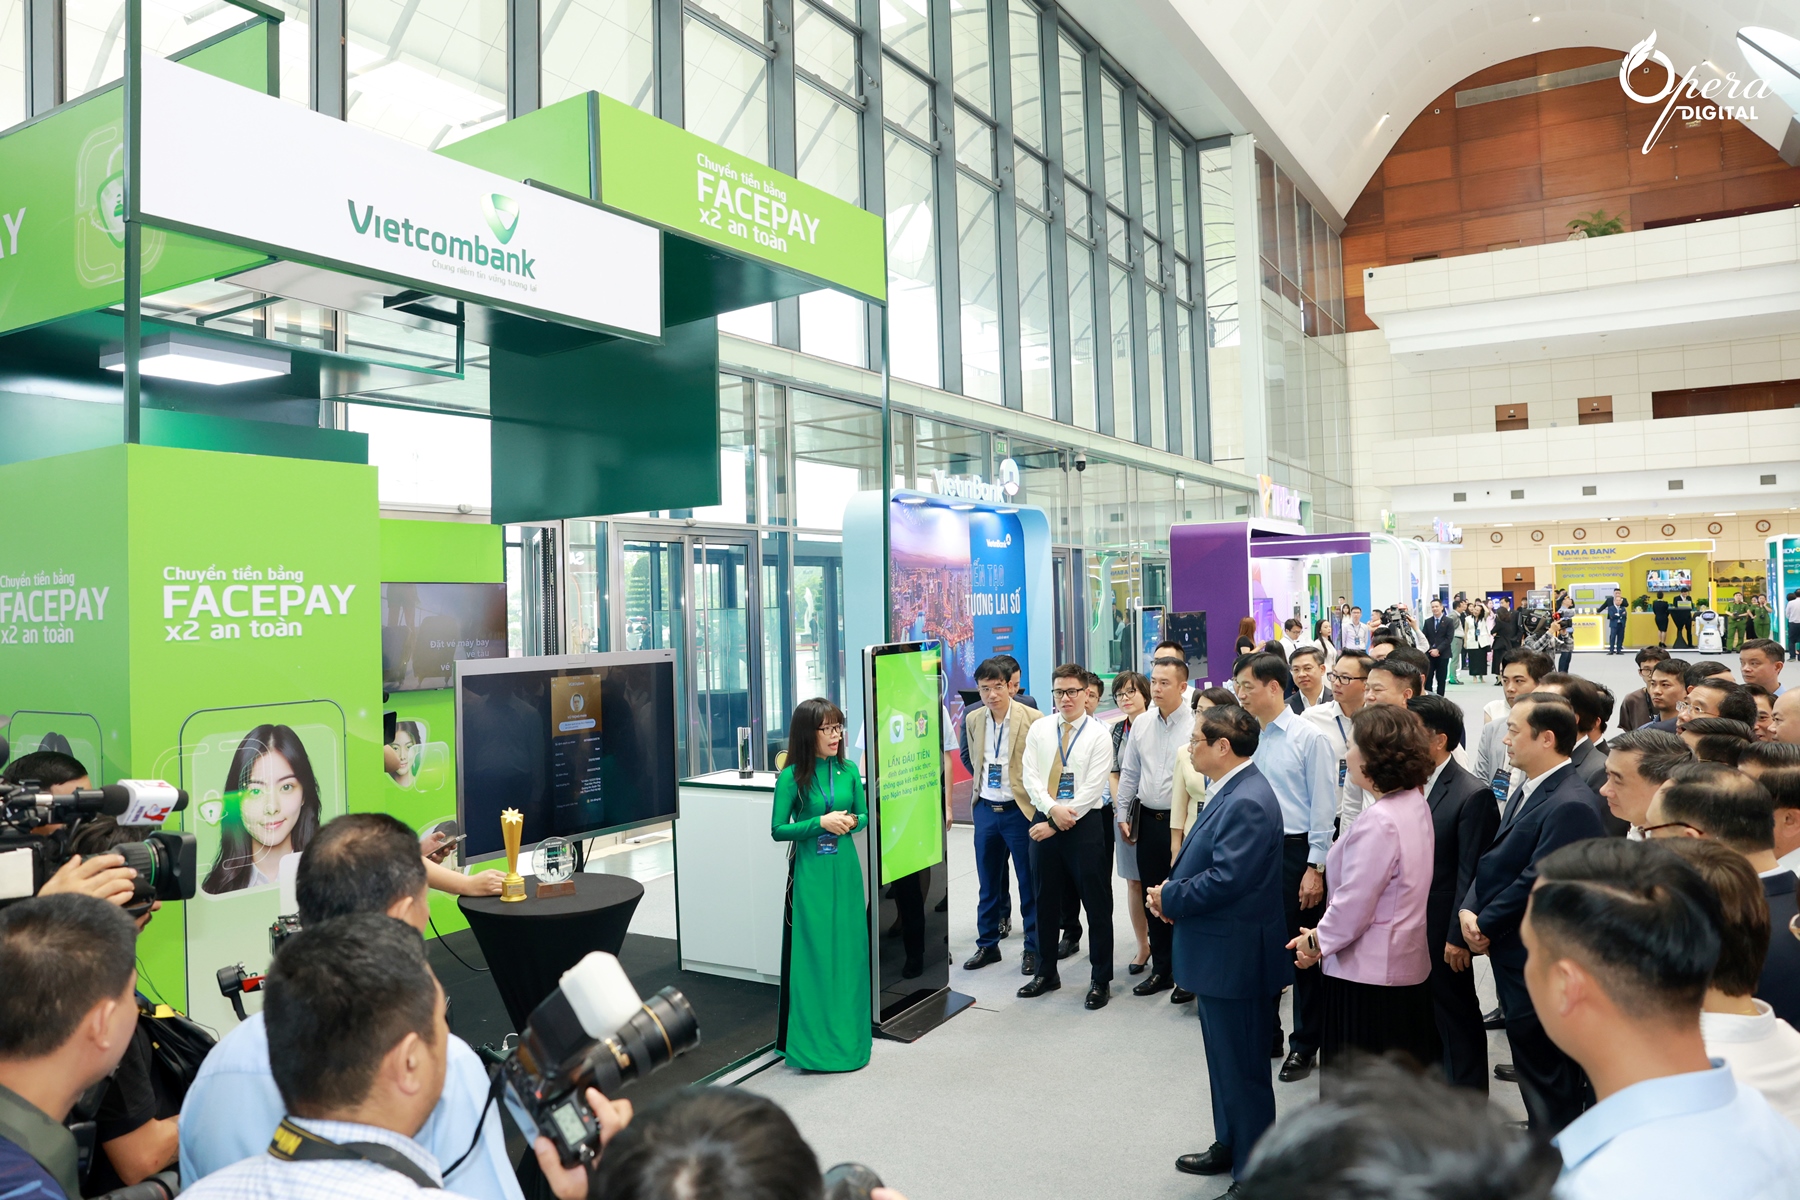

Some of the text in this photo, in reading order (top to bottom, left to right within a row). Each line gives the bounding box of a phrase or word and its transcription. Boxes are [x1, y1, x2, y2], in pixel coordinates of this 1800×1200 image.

[697, 153, 738, 180] Chuyển
[741, 172, 760, 190] tiền
[697, 169, 820, 245] FACEPAY
[348, 198, 536, 280] Vietcombank
[699, 207, 788, 253] x2 an toàn
[432, 259, 455, 273] Chung
[477, 270, 486, 279] tin
[530, 284, 538, 292] lai
[931, 468, 1005, 503] VietinBank
[34, 570, 50, 586] tiền
[163, 563, 304, 583] Chuyển tiền bằng
[0, 586, 110, 623] FACEPAY
[163, 584, 356, 619] FACEPAY
[965, 587, 1021, 617] TƯƠNG LAI SỐ
[1, 622, 74, 644] x2 an toàn
[165, 617, 302, 641] x2 an toàn
[430, 639, 490, 650] Đặt vé máy bay
[466, 649, 476, 658] vé
[440, 662, 450, 671] vé
[917, 749, 931, 760] TIÊN
